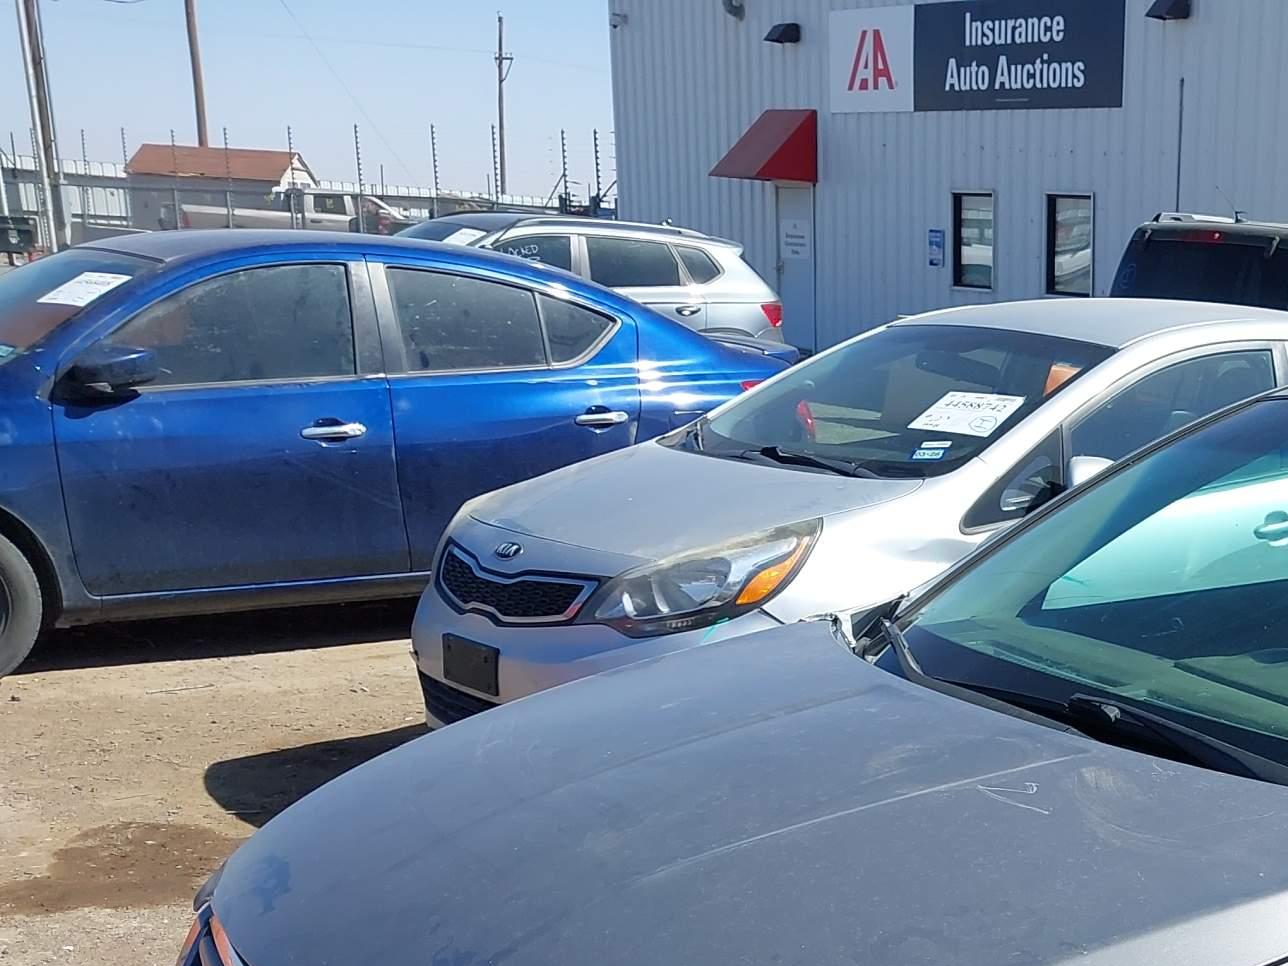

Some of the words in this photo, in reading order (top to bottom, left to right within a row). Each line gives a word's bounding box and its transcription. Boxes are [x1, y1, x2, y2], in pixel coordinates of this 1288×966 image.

[965, 12, 1065, 46] Insurance
[945, 57, 989, 91] Auto
[994, 53, 1085, 90] Auctions
[497, 542, 519, 557] KIA
